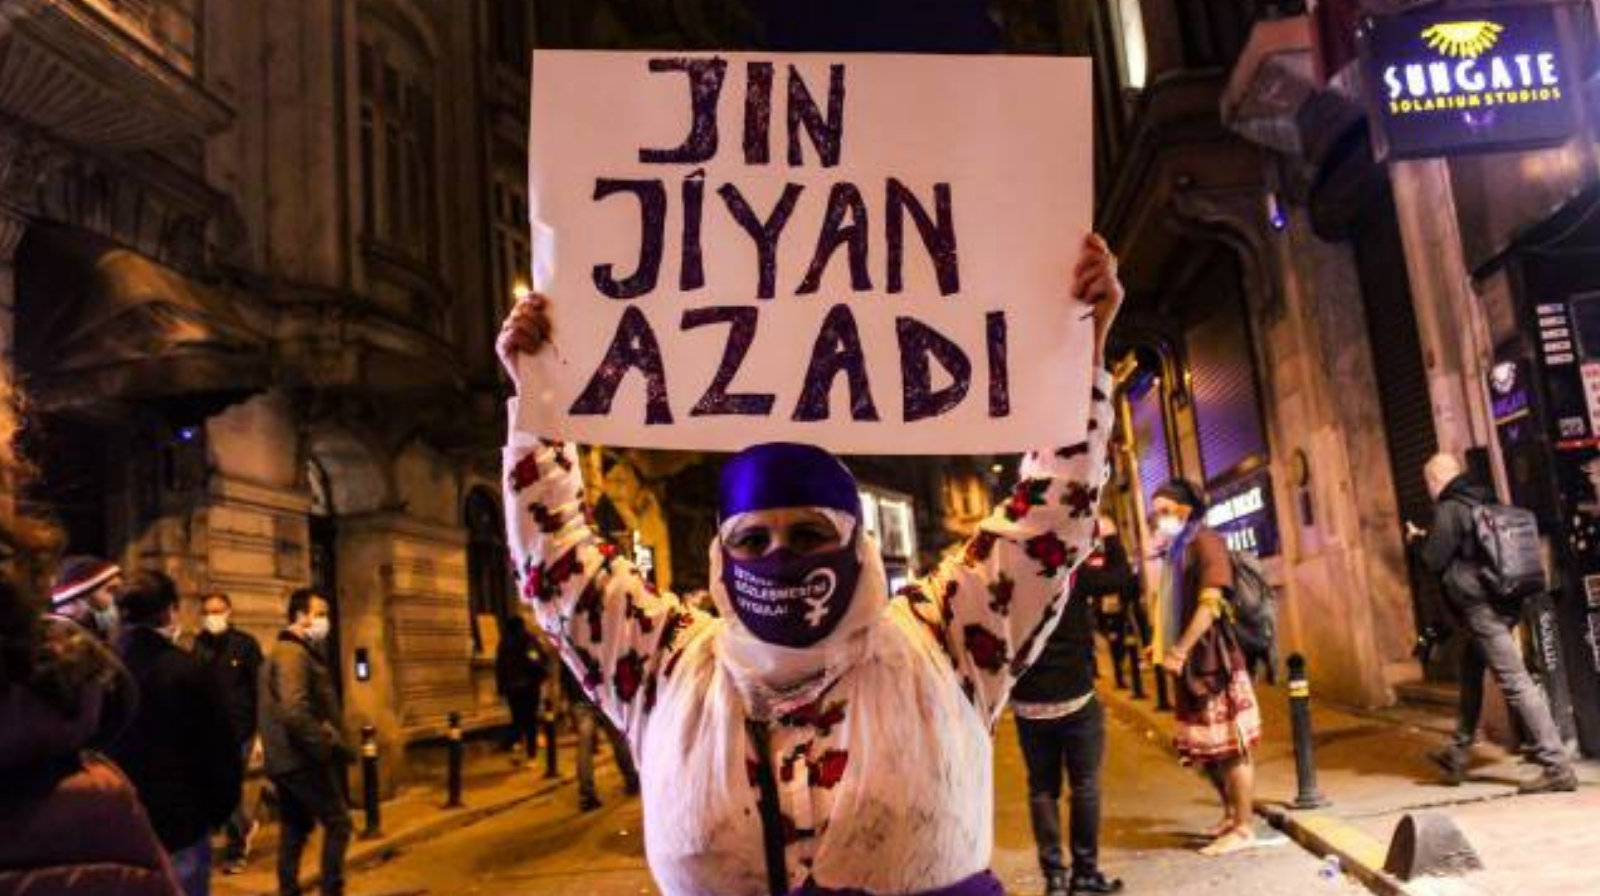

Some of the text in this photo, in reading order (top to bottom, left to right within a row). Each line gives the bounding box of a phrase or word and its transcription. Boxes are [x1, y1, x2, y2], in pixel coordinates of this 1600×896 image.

[638, 55, 846, 168] JIN
[1384, 53, 1558, 98] SUNGATE
[1389, 87, 1561, 114] SOLARIUM STUDIOS
[568, 303, 1011, 425] AZADI
